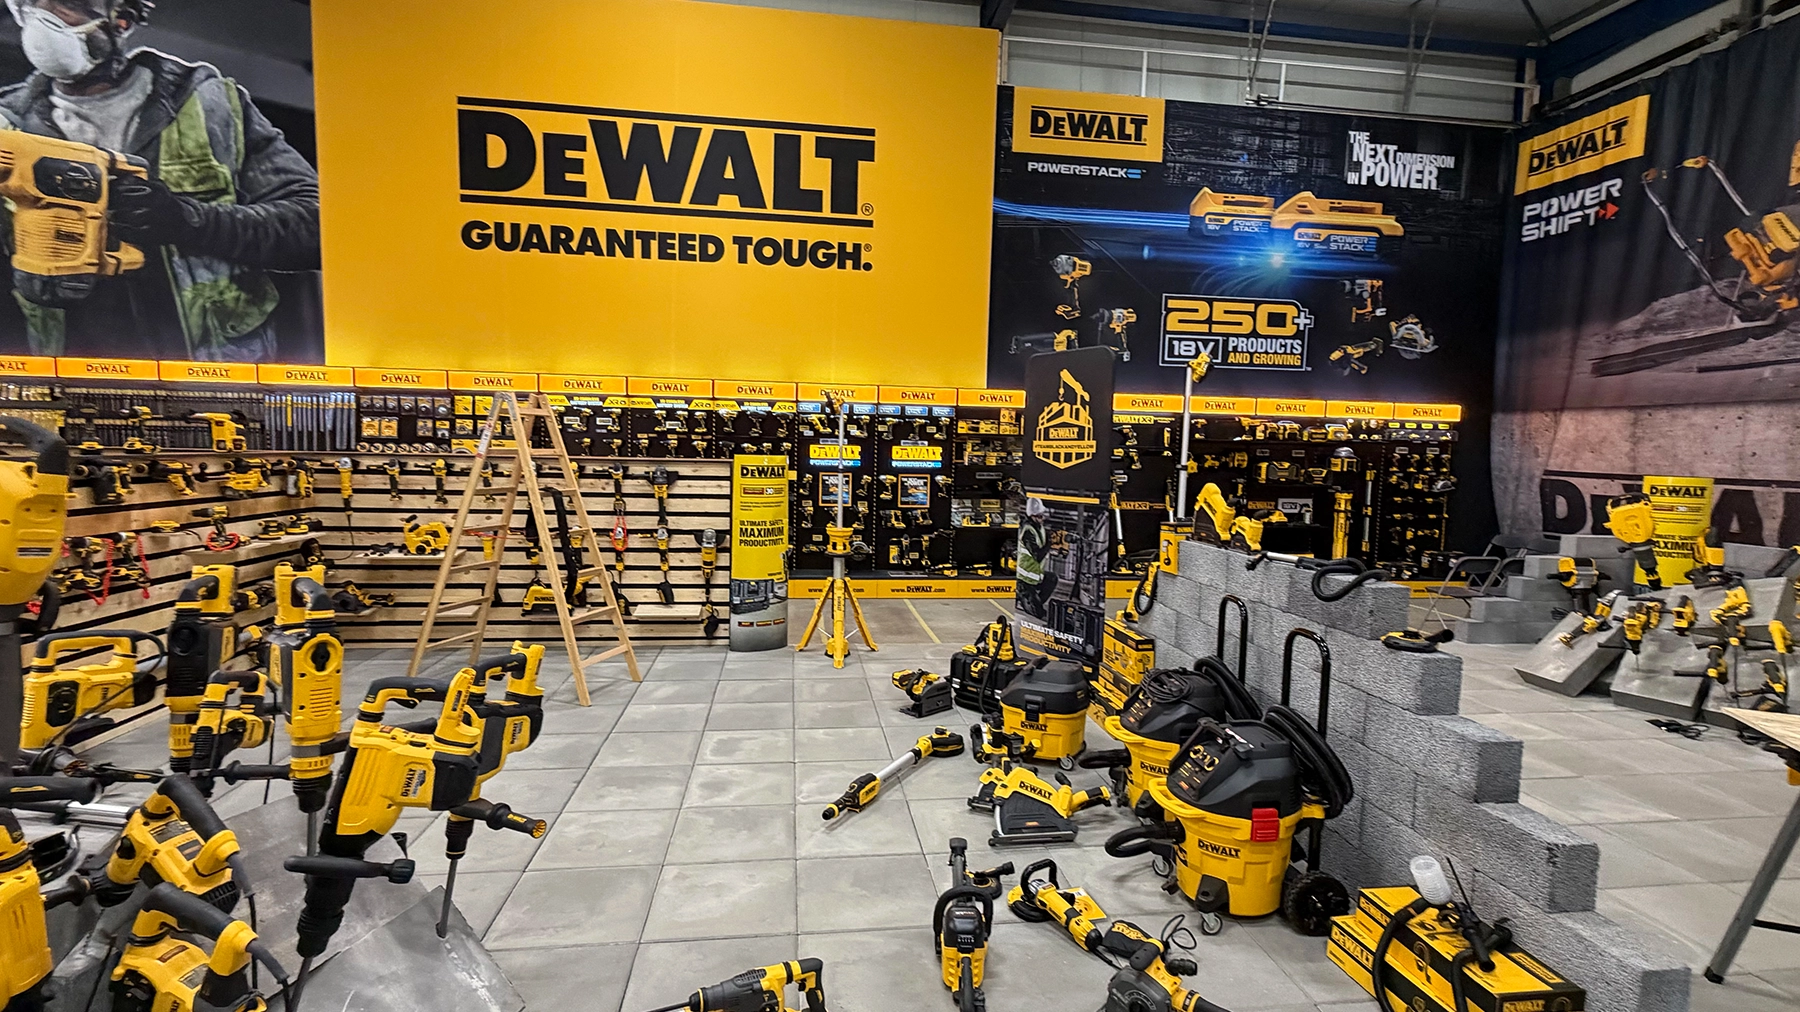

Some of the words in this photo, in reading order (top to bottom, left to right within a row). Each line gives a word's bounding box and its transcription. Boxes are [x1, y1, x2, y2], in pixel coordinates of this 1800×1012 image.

[1348, 130, 1371, 144] THE
[1352, 142, 1398, 164] NEXT
[1395, 151, 1456, 169] DIMENSION
[1027, 162, 1127, 178] POWERSTACK
[1346, 171, 1360, 185] IN
[1359, 160, 1439, 191] POWER
[1522, 177, 1623, 223] POWER
[1233, 219, 1263, 227] POWER
[1520, 205, 1600, 242] SHIFT
[460, 219, 725, 263] GUARANTEED
[1329, 242, 1365, 252] STACK
[1330, 234, 1369, 244] POWER
[1171, 339, 1216, 356] 18V
[1227, 336, 1303, 354] PRODUCTS
[1227, 352, 1250, 364] AND
[1252, 354, 1302, 366] GROWING
[740, 465, 786, 478] DEWALT
[1650, 486, 1707, 497] DEWALT
[739, 526, 785, 538] MAXIMUM
[1020, 619, 1056, 637] ULTIMATE
[1054, 629, 1084, 645] SAFETY
[1019, 632, 1072, 654] PRODUCTIVITY
[1020, 721, 1048, 732] DEWALT
[1140, 760, 1169, 775] DEWAL
[1019, 780, 1053, 801] DEWALT
[1198, 839, 1241, 859] DEWALT
